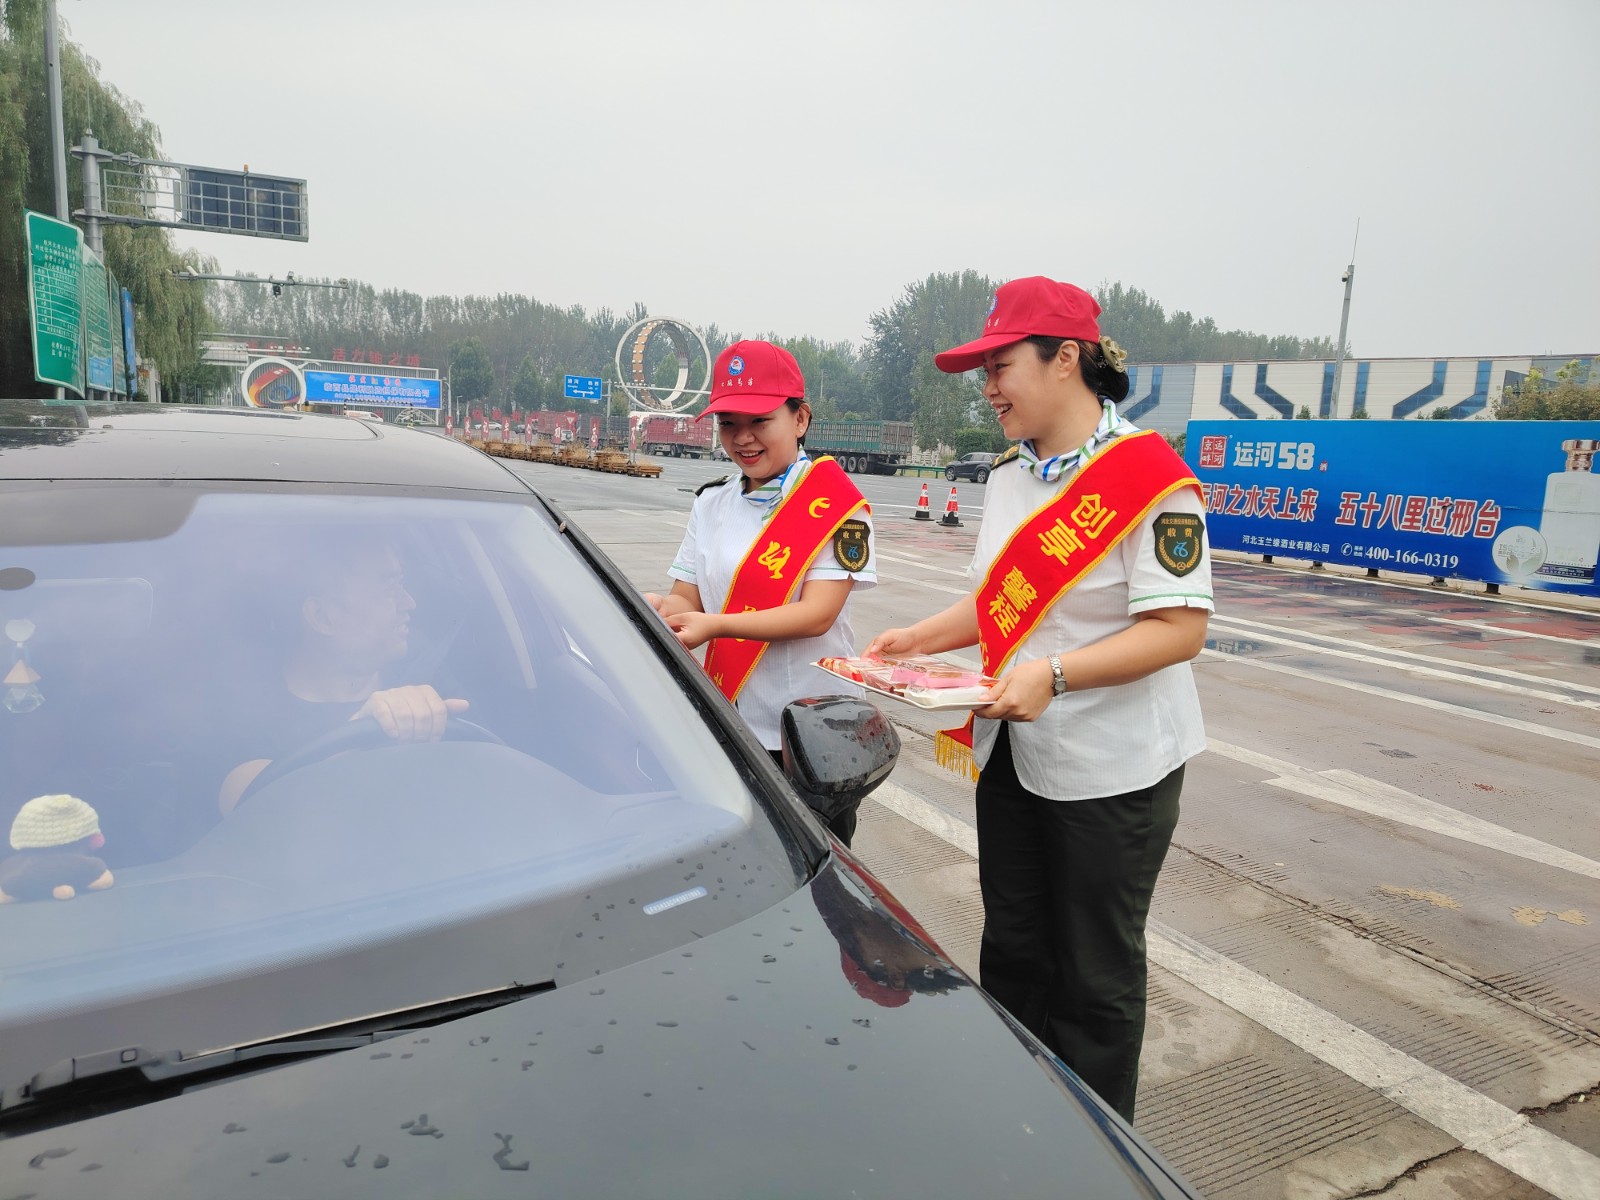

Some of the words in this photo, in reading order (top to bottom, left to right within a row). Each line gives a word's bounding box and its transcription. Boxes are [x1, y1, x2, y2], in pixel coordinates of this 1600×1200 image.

[1233, 441, 1316, 470] 运河58
[1335, 492, 1501, 539] 五十八里过邢台
[1167, 527, 1193, 538] 收费
[1242, 533, 1331, 555] 河北玉兰缘酒业有限公司
[1365, 546, 1460, 570] 400-166-0319
